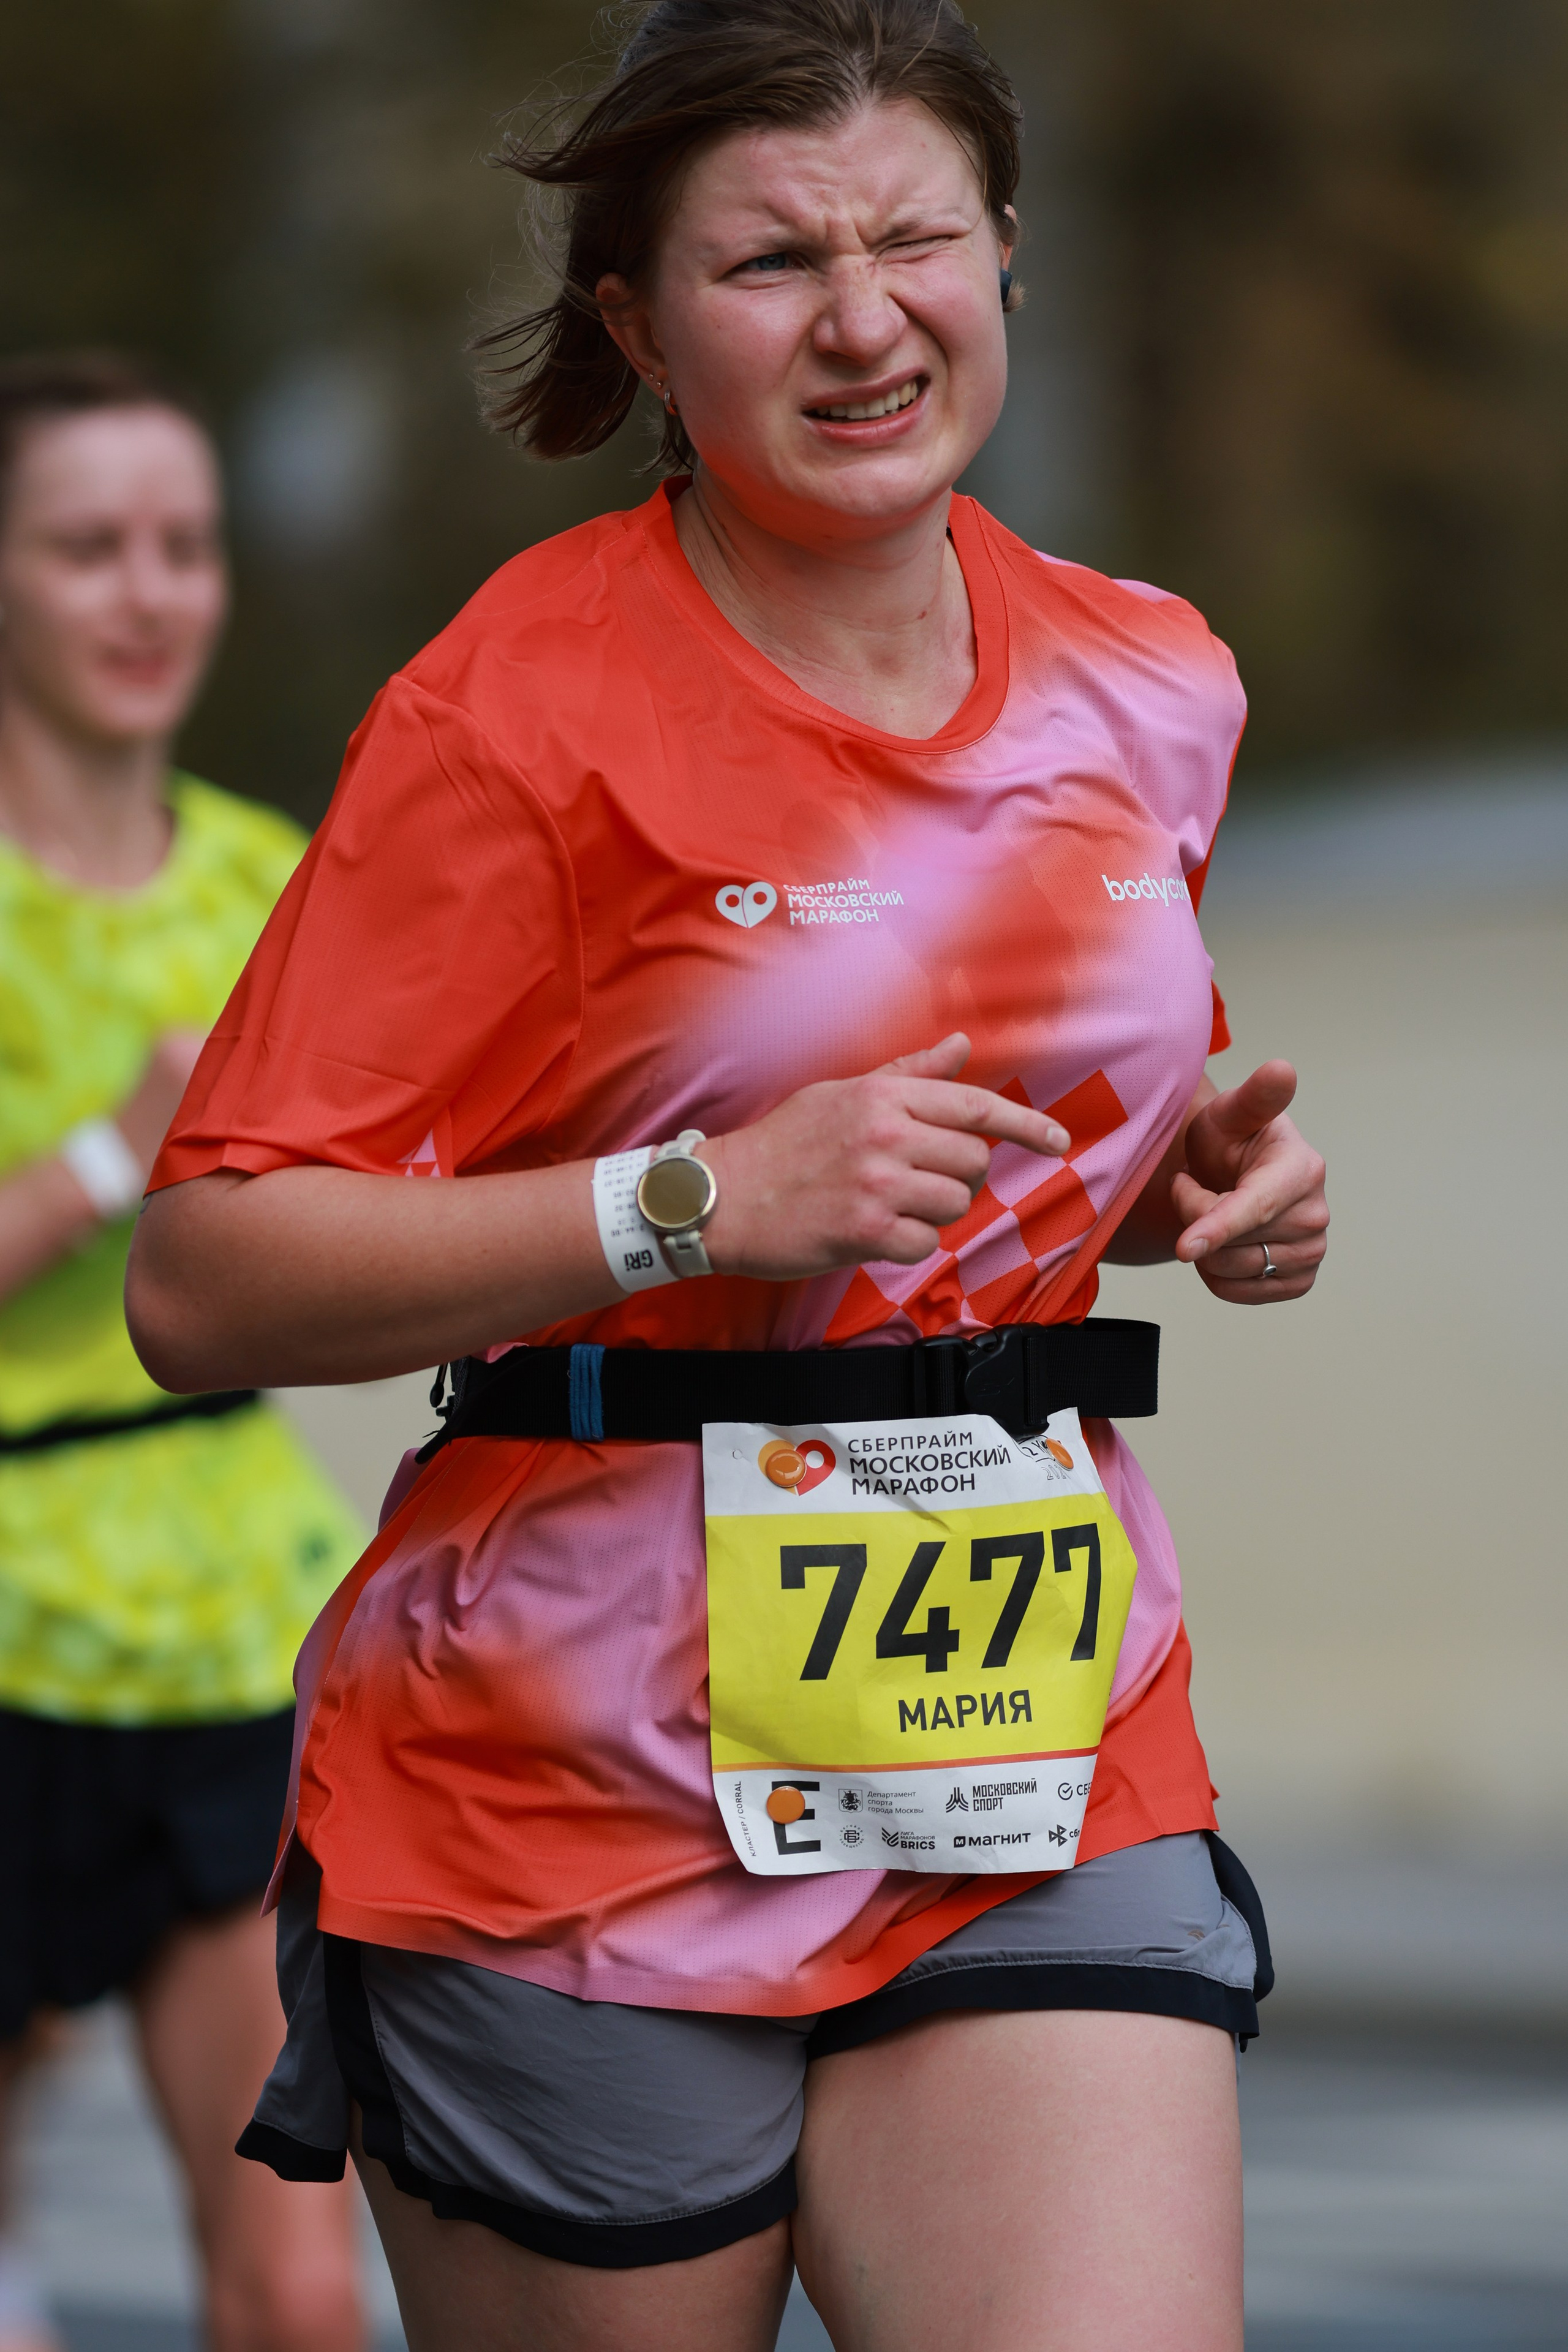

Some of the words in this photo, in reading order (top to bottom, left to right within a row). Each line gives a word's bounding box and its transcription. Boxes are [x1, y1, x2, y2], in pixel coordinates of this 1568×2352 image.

[783, 878, 870, 894] СБЕРПРАЙМ
[788, 890, 904, 908] МОСКОВСКИЙ
[790, 909, 879, 925] МАРАФОН
[848, 1431, 972, 1453] СБЕРПРАЙМ
[850, 1444, 1011, 1474] МОСКОВСКИЙ
[852, 1473, 975, 1495] МАРАФОН
[780, 1523, 1101, 1681] 7477
[898, 1689, 1032, 1733] МАРИЯ
[736, 1781, 744, 1814] CORRAL
[973, 1778, 1037, 1798] МОСКОВСКИЙ
[973, 1797, 1003, 1811] СПОРТ
[741, 1822, 756, 1857] КЛАСТЕР
[900, 1841, 935, 1850] BRICS
